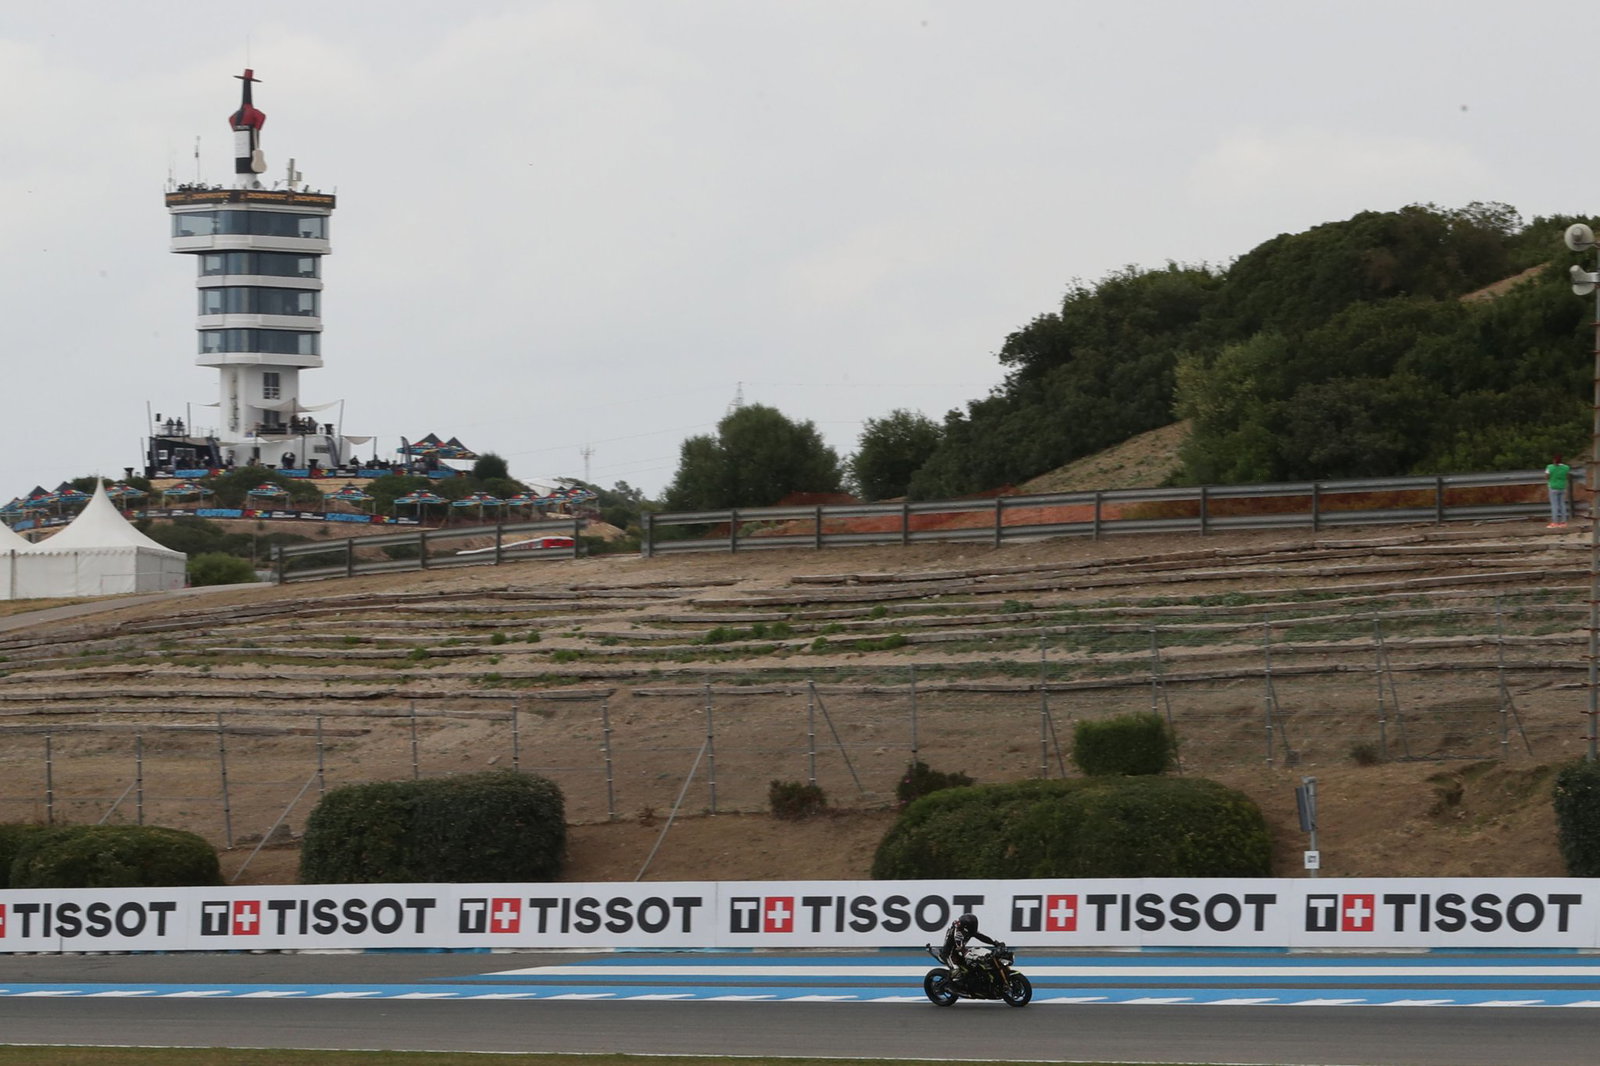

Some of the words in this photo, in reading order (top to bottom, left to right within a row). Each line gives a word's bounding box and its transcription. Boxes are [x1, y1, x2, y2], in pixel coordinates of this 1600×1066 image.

[13, 902, 176, 938] TISSOT
[268, 898, 436, 935] TISSOT
[530, 897, 702, 933] TISSOT
[802, 895, 984, 932] TISSOT
[1086, 893, 1276, 931] TISSOT
[1384, 894, 1582, 932] TISSOT
